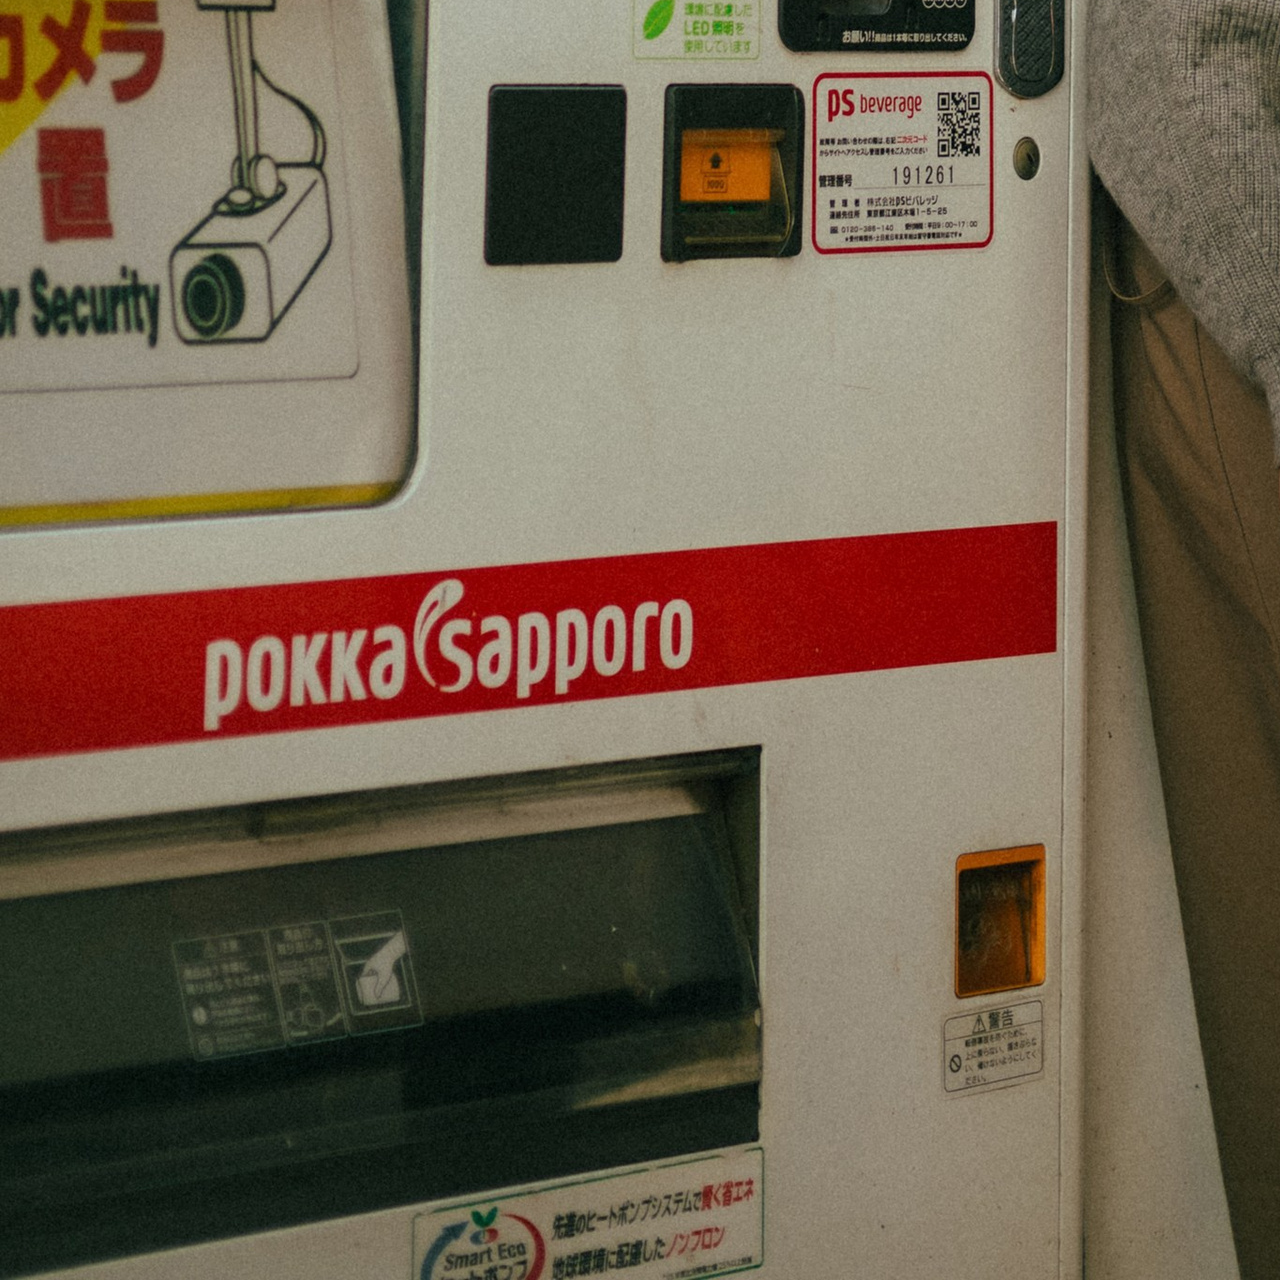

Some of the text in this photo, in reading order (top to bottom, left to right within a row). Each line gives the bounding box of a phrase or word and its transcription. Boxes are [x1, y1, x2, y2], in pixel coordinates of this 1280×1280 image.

[683, 20, 710, 36] LED
[683, 39, 753, 55] 使用しています
[859, 93, 923, 120] beverage
[819, 164, 955, 188] 管理番号 191261
[30, 265, 161, 348] Security
[988, 1008, 1014, 1030] 警告
[443, 1242, 527, 1272] Smart Eco
